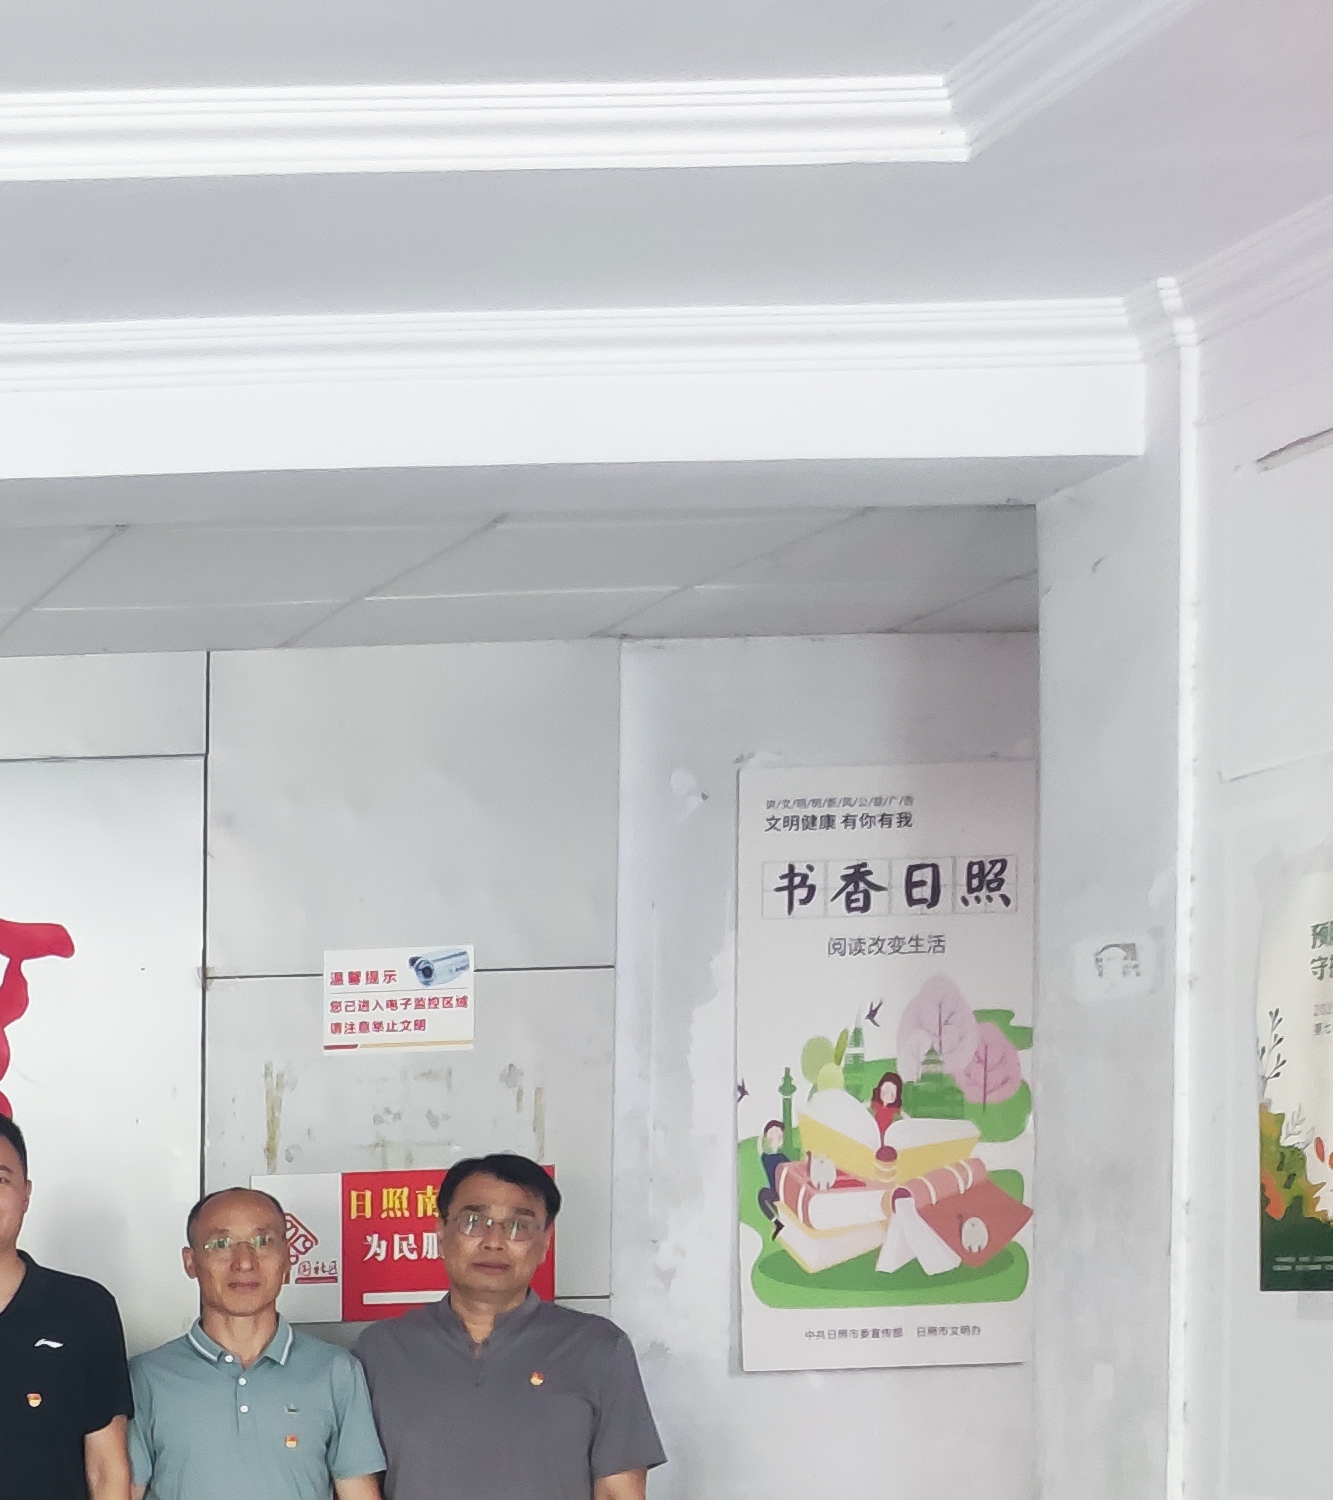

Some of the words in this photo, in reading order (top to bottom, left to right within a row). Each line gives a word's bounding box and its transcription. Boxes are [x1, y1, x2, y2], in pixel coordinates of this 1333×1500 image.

[764, 813, 837, 833] 文明健康
[840, 811, 914, 831] 有你有我
[773, 857, 1013, 917] 书香日照
[827, 934, 946, 957] 阅读改变生活
[330, 969, 398, 986] 温馨提示
[329, 995, 469, 1013] 您已进入电子监控区域
[330, 1018, 427, 1035] 请注意举止文明
